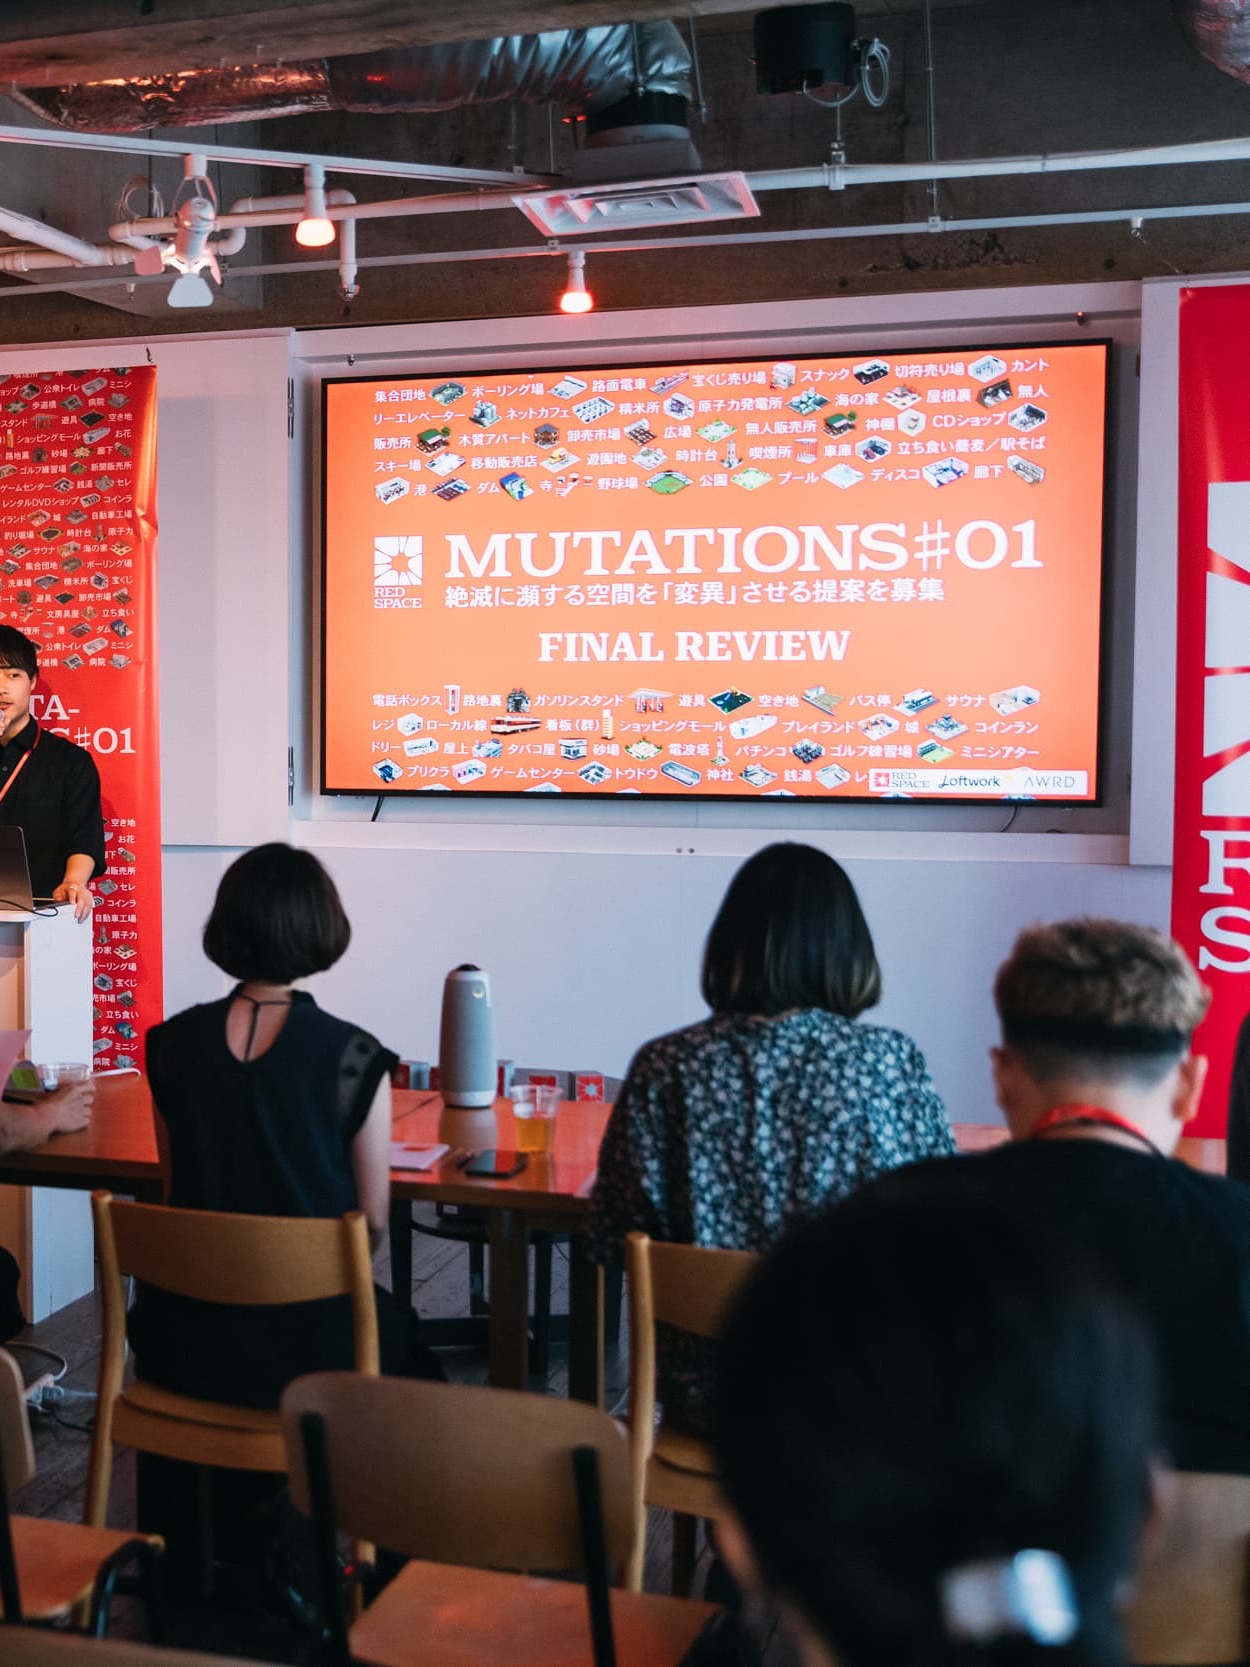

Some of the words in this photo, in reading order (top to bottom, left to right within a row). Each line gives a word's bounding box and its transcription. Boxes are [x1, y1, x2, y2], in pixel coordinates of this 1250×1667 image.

[109, 381, 132, 389] ミニシ
[374, 389, 426, 403] 集合団地
[472, 382, 544, 398] ボーリング場
[592, 378, 647, 393] 路面電車
[692, 370, 767, 388] 宝くじ売り場
[800, 367, 850, 382] スナック
[895, 361, 964, 378] 切符売り場
[1012, 358, 1050, 373] カント
[374, 411, 465, 425] リーエレベーター
[506, 406, 570, 421] ネットカフェ
[619, 401, 660, 415] 精米所
[698, 396, 783, 413] 原子力発電所
[835, 392, 879, 407] 海の家
[926, 388, 971, 403] 屋根裏
[1018, 384, 1049, 398] 無人
[17, 433, 81, 444] ショッピングモール
[115, 429, 132, 438] お花
[374, 436, 412, 450] 販売所
[567, 427, 621, 442] 卸売市場
[664, 425, 692, 439] 広場
[746, 421, 817, 436] 無人販売所
[932, 411, 1007, 428] CDショップ
[374, 459, 422, 472] スキー場
[471, 454, 538, 469] 移動販売店
[586, 452, 627, 466] 遊園地
[675, 449, 718, 463] 時計台
[824, 444, 852, 458] 車庫
[0, 482, 52, 492] ゲームセンター
[116, 478, 131, 486] セレ
[414, 483, 427, 496] 港
[477, 480, 500, 494] ダム
[539, 478, 553, 492] 寺
[597, 476, 639, 490] 野球場
[700, 473, 728, 487] 公園
[778, 471, 819, 485] プール
[871, 468, 921, 482] ディスコ
[974, 465, 1004, 480] 廊下
[2, 496, 80, 508] レンタルDVDショップ
[104, 495, 132, 504] コインラ
[34, 547, 55, 555] サウナ
[444, 519, 1043, 578] MUTATIONS#01
[374, 586, 405, 597] RED
[374, 596, 423, 609] SPACE
[111, 640, 133, 649] ミニシ
[538, 629, 665, 664] FINAL
[674, 629, 852, 663] REVIEW
[373, 694, 441, 707] 電話ボックス
[463, 694, 502, 707] 路地裏
[534, 694, 624, 707] ガソリンスタンド
[679, 694, 705, 707] 遊具
[758, 694, 799, 708] 空き地
[849, 694, 891, 708] バス停
[947, 694, 986, 707] サウナ
[373, 719, 395, 731] レジ
[427, 719, 487, 732] ローカル線
[619, 719, 726, 733] ショッピングモール
[782, 720, 854, 734] プレイランド
[904, 721, 919, 734] 城
[974, 721, 1039, 734] コインラン
[371, 741, 400, 753] ドリー
[443, 742, 468, 756] 屋上
[508, 742, 556, 756] タバコ屋
[593, 742, 620, 756] 砂場
[668, 742, 710, 756] 電波塔
[736, 743, 787, 757] パチンコ
[830, 744, 912, 758] ゴルフ練習場
[961, 745, 1040, 758] ミニシアター
[407, 765, 449, 778] プリクラ
[492, 766, 574, 780] ゲームセンター
[614, 767, 658, 780] トウドウ
[706, 768, 735, 781] 神社
[784, 768, 812, 782] 銭湯
[891, 772, 918, 780] RED
[891, 779, 931, 789] SPACE
[938, 773, 1001, 789] Loftwork
[1024, 776, 1076, 788] AWRD
[116, 979, 138, 987] 宝くじ
[101, 1026, 115, 1034] ダム
[115, 1043, 138, 1051] ミニシ
